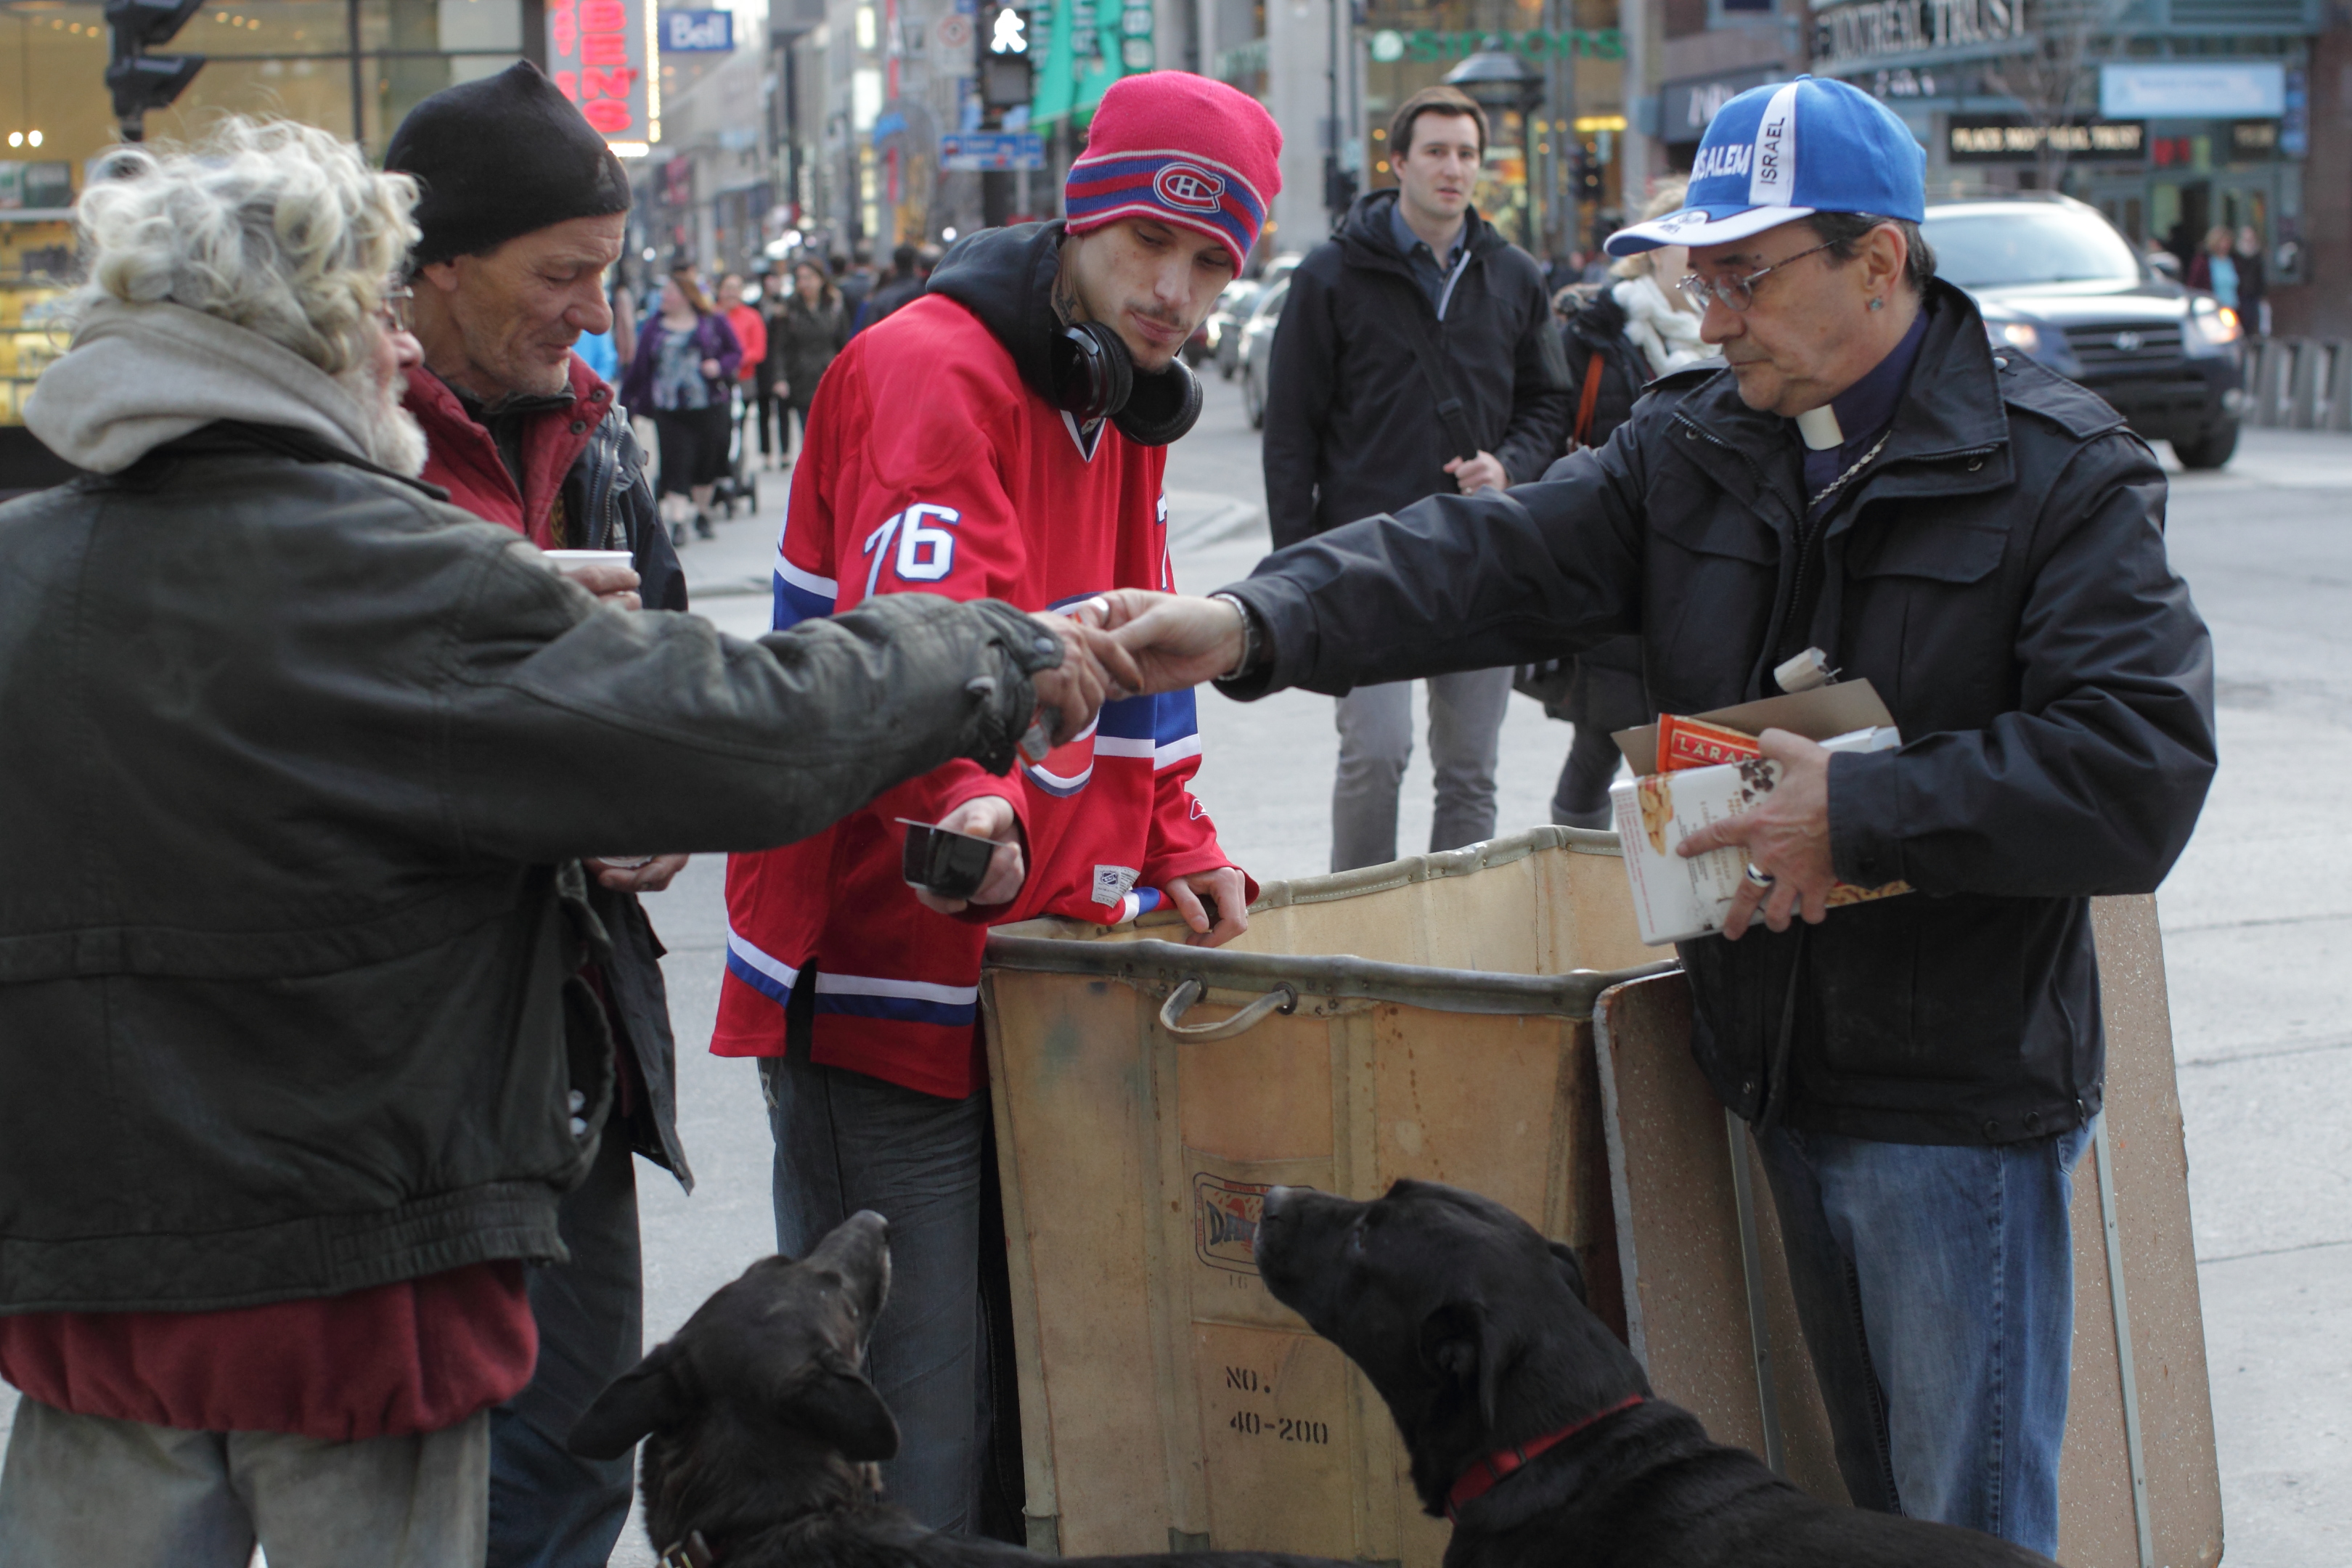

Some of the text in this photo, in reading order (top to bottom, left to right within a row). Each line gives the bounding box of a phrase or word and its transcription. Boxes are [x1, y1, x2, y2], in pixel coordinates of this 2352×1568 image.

[669, 13, 727, 49] Bell
[1760, 116, 1786, 186] ISRAEL
[862, 502, 963, 600] 76
[1226, 1365, 1270, 1393] NO.
[1230, 1410, 1328, 1445] 40-200
